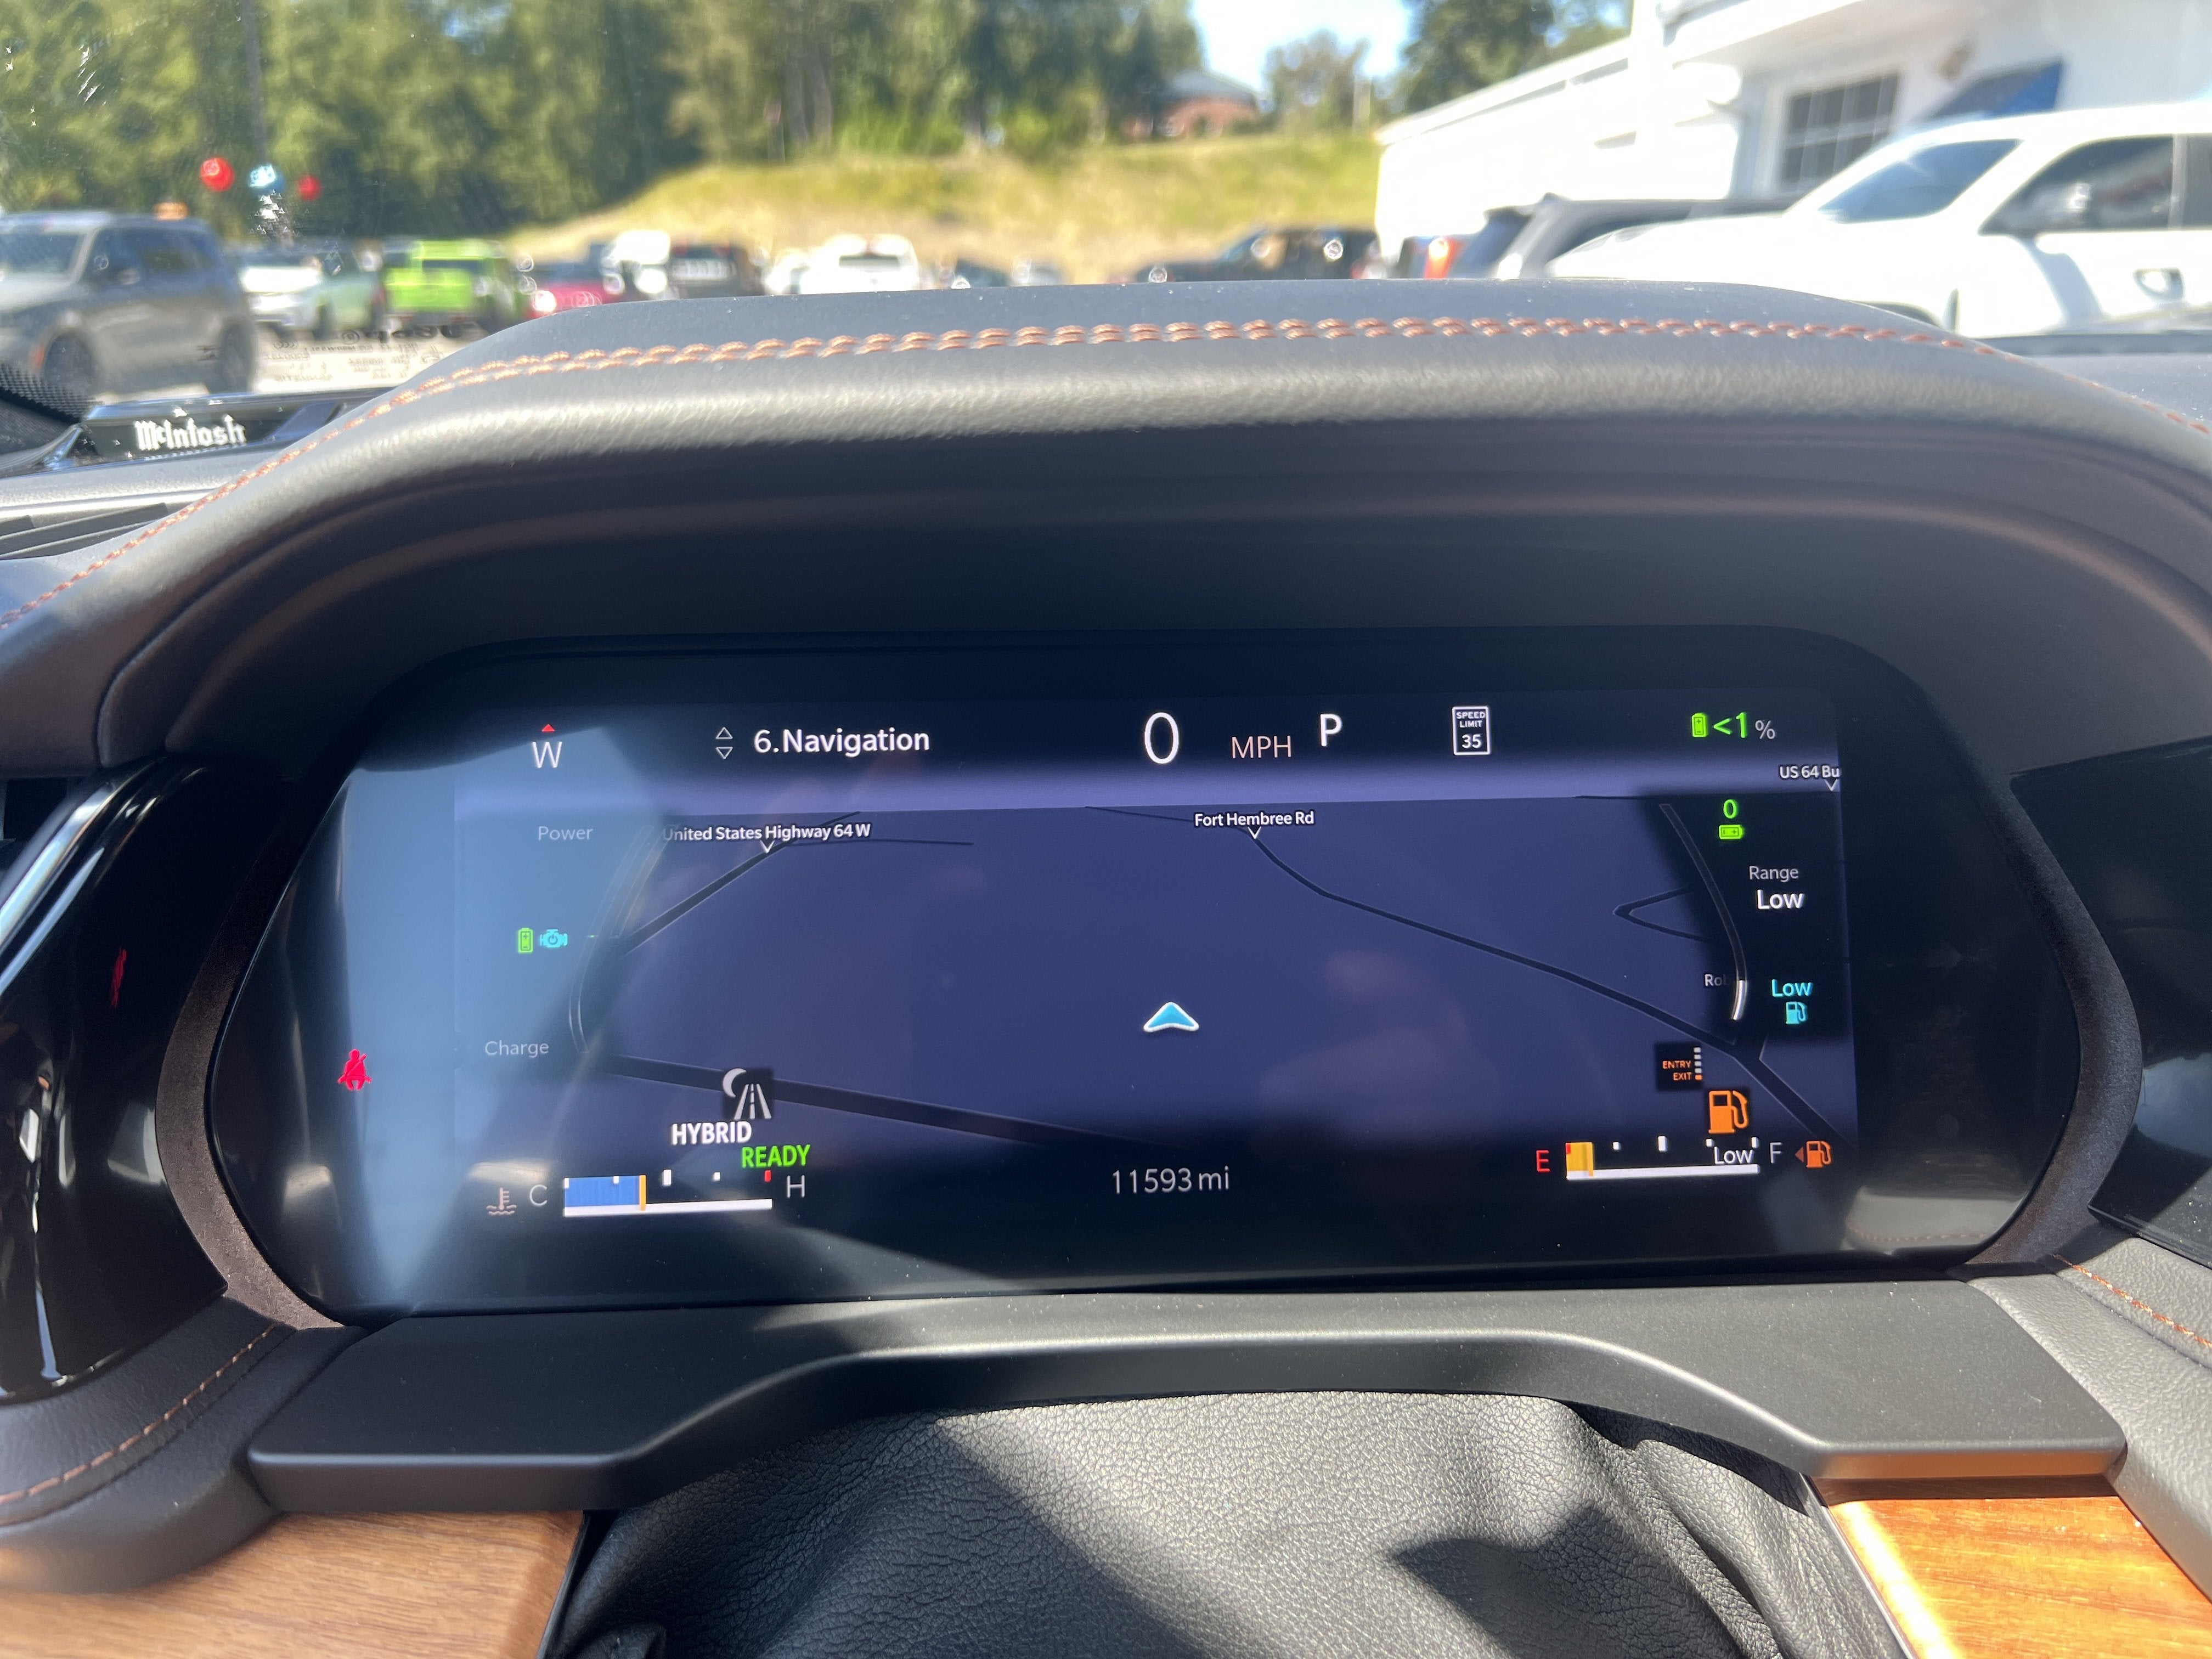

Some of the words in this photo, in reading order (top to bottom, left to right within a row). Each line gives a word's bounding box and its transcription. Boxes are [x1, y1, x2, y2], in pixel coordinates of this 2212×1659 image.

[1456, 711, 1486, 719] SPEED
[1459, 720, 1483, 728] LIMIT
[1144, 712, 1180, 764] 0
[1320, 713, 1342, 747] P
[754, 727, 929, 758] 6.Navigation
[1232, 735, 1291, 759] MPH
[1462, 733, 1482, 749] 35
[532, 741, 563, 769] W
[1780, 765, 1799, 778] US
[1801, 765, 1819, 778] 64
[1822, 765, 1840, 778] Bu
[1195, 813, 1224, 827] Fort
[1227, 812, 1293, 826] Hembree
[1295, 810, 1314, 825] Rd
[1723, 799, 1737, 819] 0
[538, 826, 594, 840] Power
[663, 826, 713, 841] United
[715, 826, 763, 840] States
[765, 825, 832, 841] Highway
[833, 823, 854, 838] 64
[855, 823, 871, 837] W
[1749, 865, 1798, 883] Range
[1757, 889, 1804, 910] Low
[1771, 979, 1813, 997] Low
[485, 1040, 549, 1057] Charge
[1662, 1060, 1691, 1069] ENTRY
[1673, 1072, 1692, 1081] EXIT
[672, 1120, 753, 1146] HYBRID
[742, 1144, 810, 1169] READY
[1536, 1149, 1550, 1172] E
[1714, 1146, 1754, 1164] Low
[1770, 1142, 1782, 1164] F
[787, 1175, 805, 1198] H
[1199, 1165, 1229, 1190] mi
[529, 1184, 548, 1206] C
